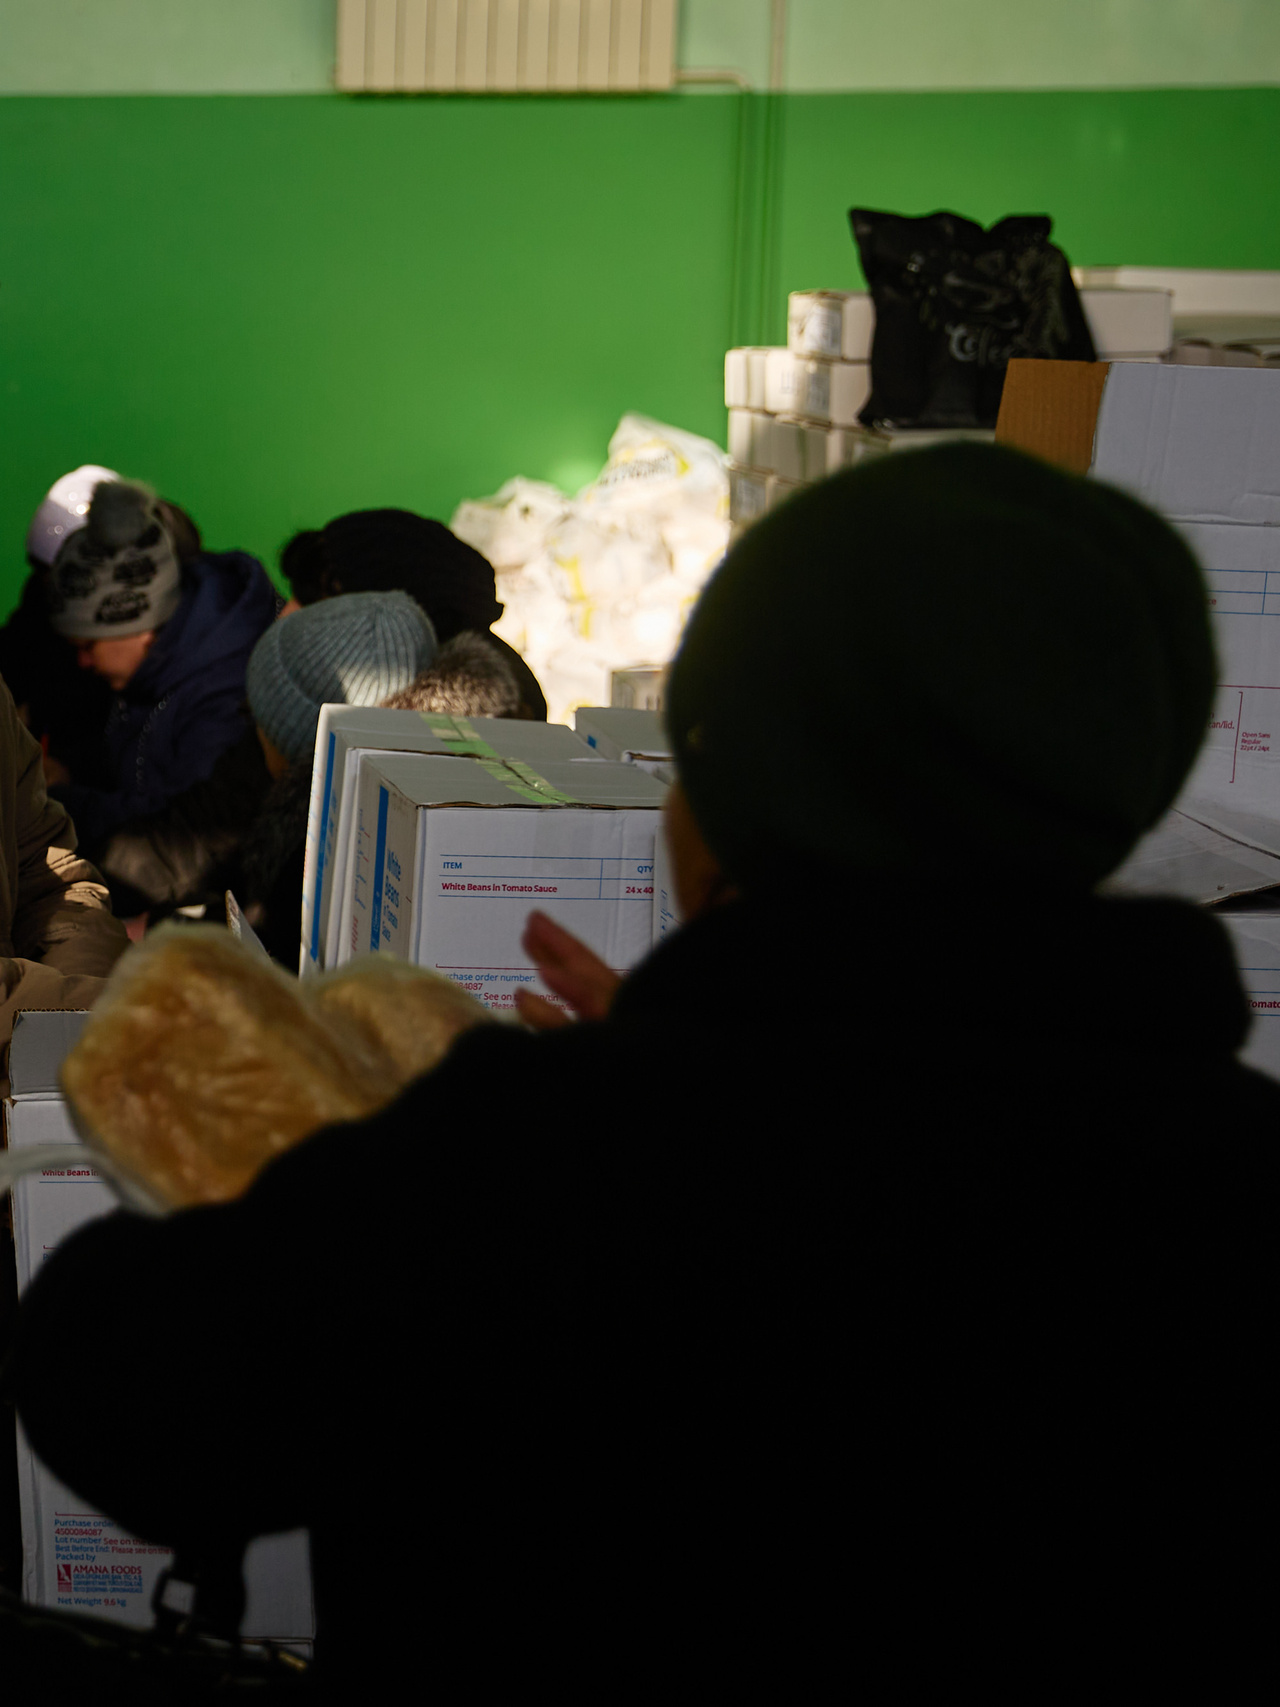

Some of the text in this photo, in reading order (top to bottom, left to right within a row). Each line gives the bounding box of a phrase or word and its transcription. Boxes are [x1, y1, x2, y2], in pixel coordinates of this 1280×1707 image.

[442, 861, 654, 874] ITEM QTY
[441, 882, 466, 891] White
[467, 883, 491, 891] Beans
[502, 884, 533, 892] Tomato
[533, 885, 558, 893] Sauce
[625, 886, 636, 894] 24
[475, 973, 499, 981] order
[500, 974, 536, 982] number:
[483, 992, 499, 1001] See
[491, 1002, 514, 1010] Please
[41, 1169, 65, 1177] White
[66, 1169, 90, 1177] Beans
[54, 1518, 91, 1527] Purchase
[54, 1528, 103, 1536] 4500084087
[55, 1536, 68, 1544] Lot
[69, 1537, 102, 1545] number
[103, 1537, 119, 1546] See
[55, 1544, 70, 1552] Best
[71, 1545, 95, 1553] Before
[111, 1546, 134, 1554] Please
[134, 1547, 147, 1555] see
[56, 1553, 96, 1563] Packed by
[73, 1565, 143, 1575] AMANA FOODS
[57, 1597, 127, 1608] Net Weight 9.6 kg
